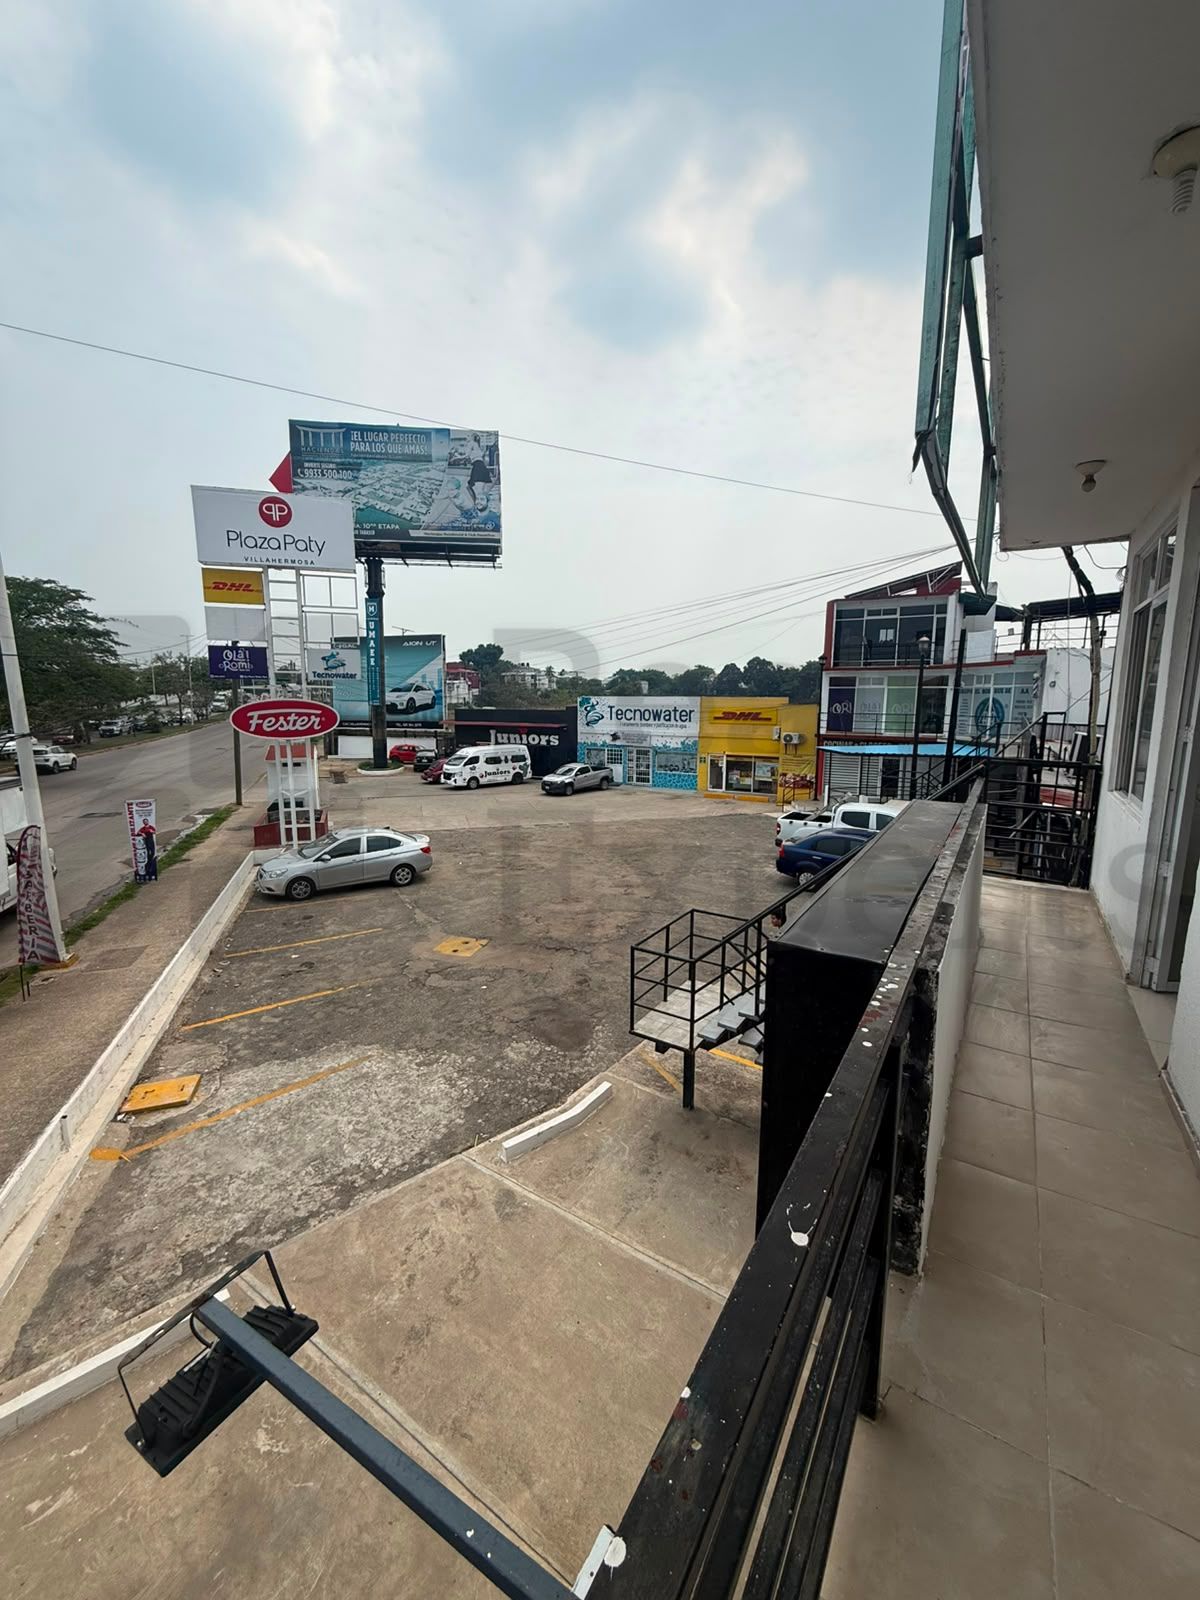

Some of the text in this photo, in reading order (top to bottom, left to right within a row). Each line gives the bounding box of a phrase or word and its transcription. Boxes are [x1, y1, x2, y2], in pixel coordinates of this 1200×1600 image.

[364, 432, 389, 442] LUGAR
[391, 433, 426, 444] PERFECTO
[350, 442, 370, 452] PARA
[372, 443, 386, 453] LOS
[387, 444, 403, 454] QUE
[304, 469, 322, 478] 9933
[226, 529, 326, 557] Plaza Paty
[243, 556, 315, 565] VILLAHERMOSA
[211, 581, 256, 592] DHL
[312, 671, 357, 679] Tecnowater
[247, 708, 323, 731] Fester
[608, 705, 695, 723] Tecnowater
[722, 711, 762, 721] DHL
[489, 729, 559, 746] Juniors
[484, 770, 511, 778] Juniors
